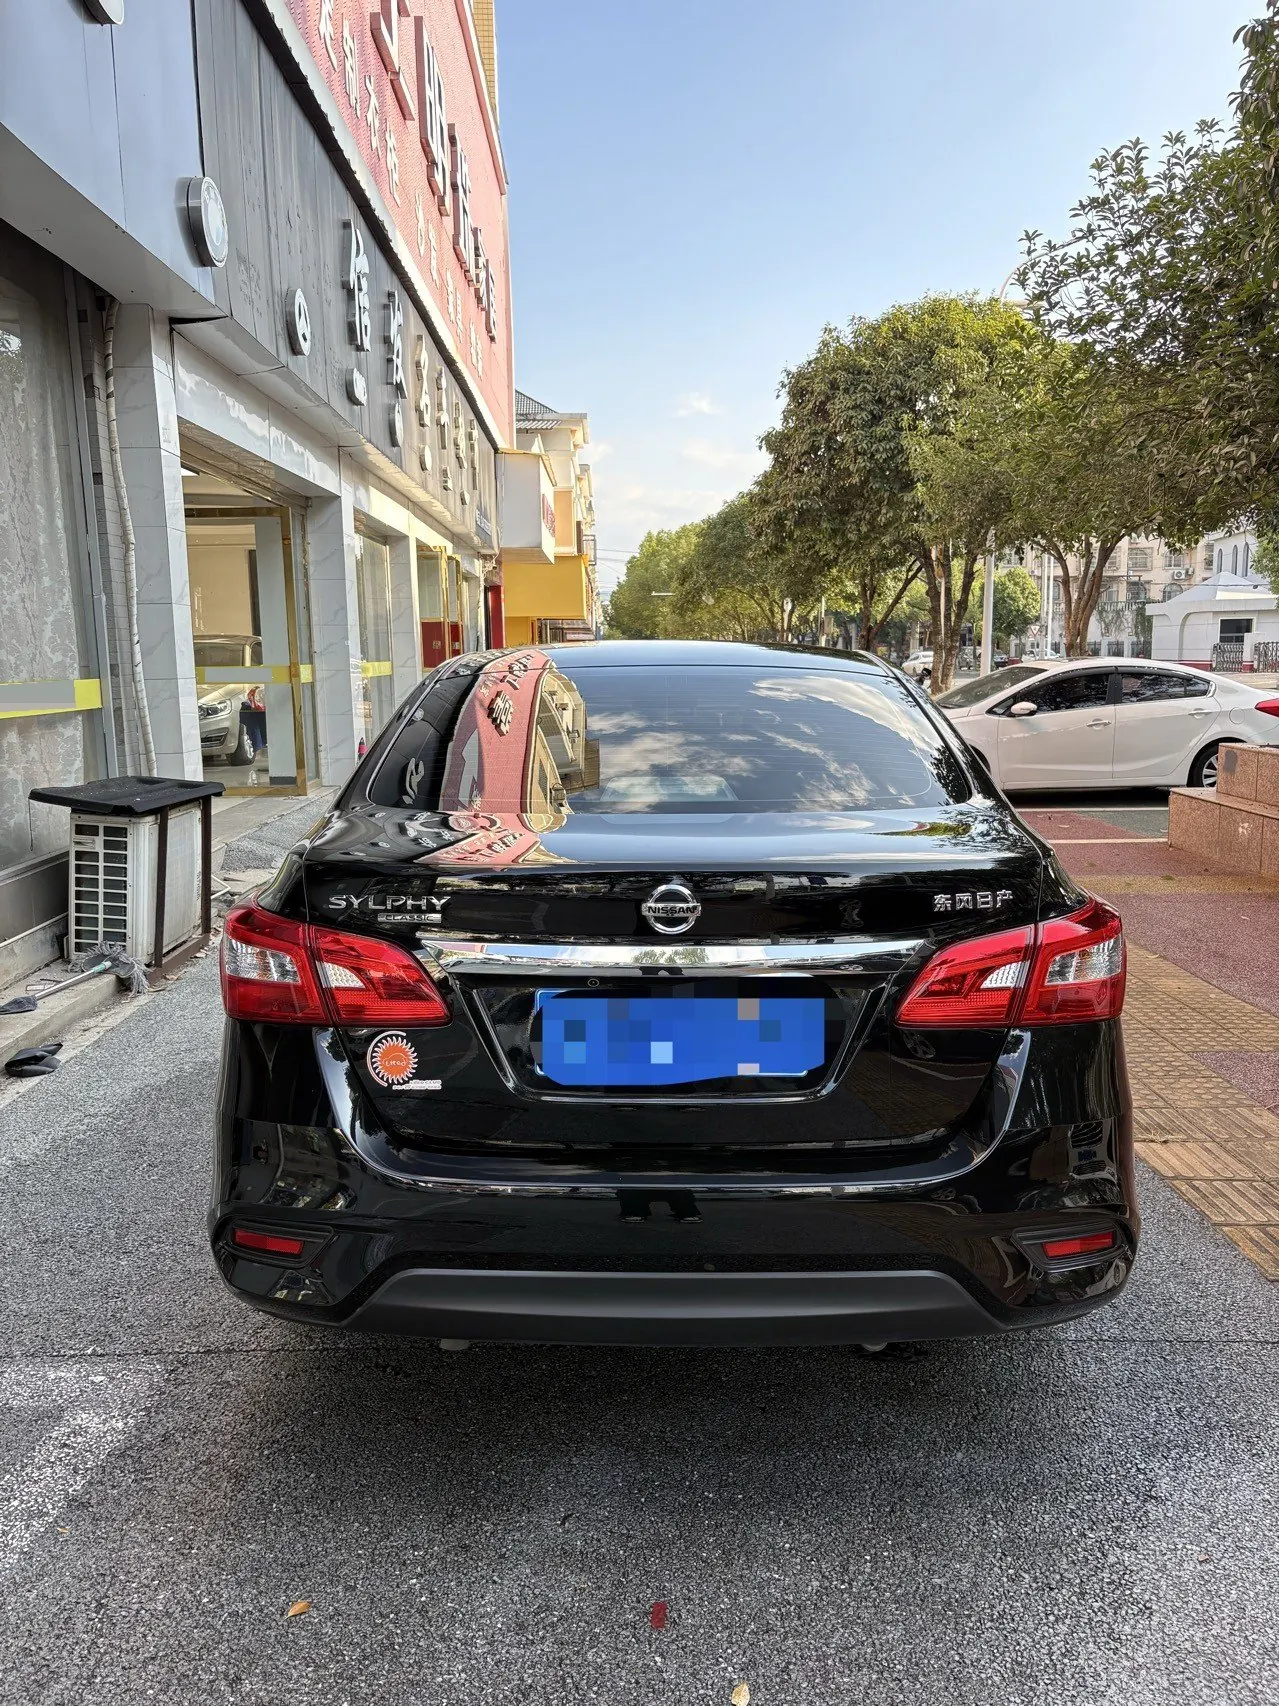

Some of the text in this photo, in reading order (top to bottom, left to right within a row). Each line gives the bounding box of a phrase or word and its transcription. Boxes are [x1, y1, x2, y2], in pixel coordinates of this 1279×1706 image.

[328, 895, 451, 911] SYLPHY
[933, 889, 1013, 912] 东风日产
[647, 906, 697, 914] NISSAN
[384, 914, 434, 923] CLASSIC
